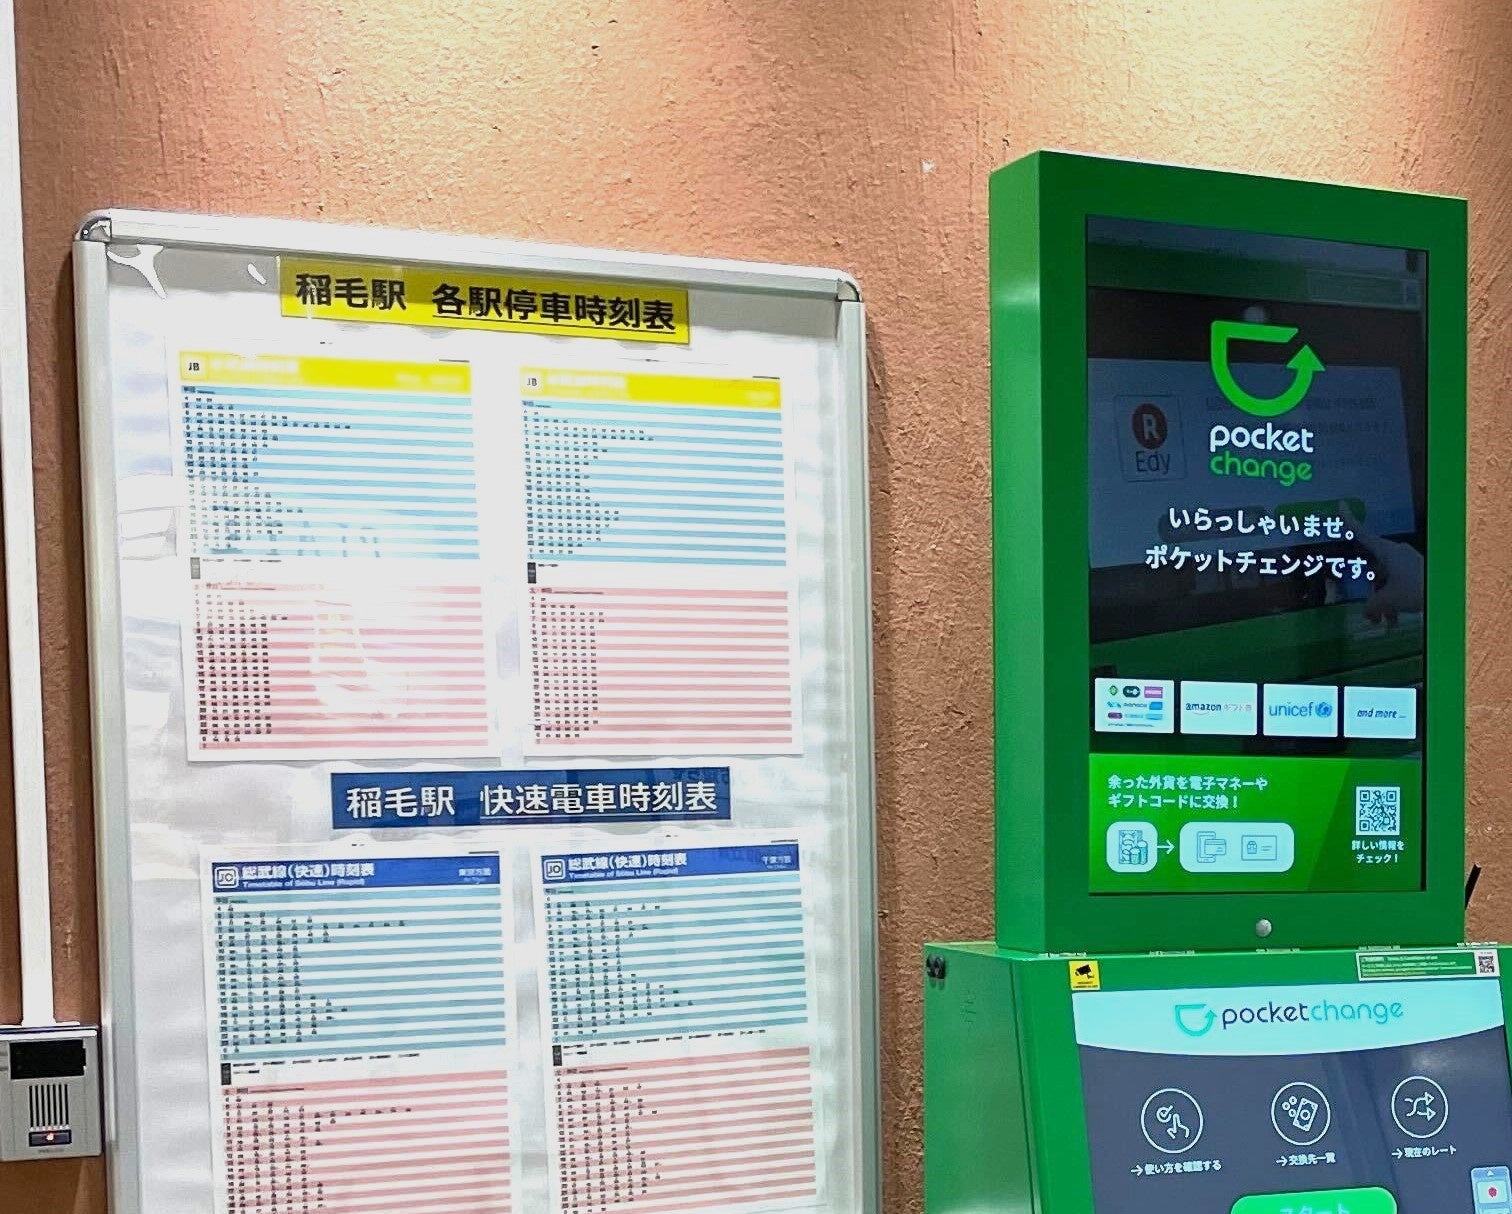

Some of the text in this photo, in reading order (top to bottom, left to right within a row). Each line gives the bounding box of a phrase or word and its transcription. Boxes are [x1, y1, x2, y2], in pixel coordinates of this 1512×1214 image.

[295, 272, 676, 332] 稲毛駅 各駅停車時刻表
[1209, 422, 1314, 453] pocket
[1135, 450, 1171, 476] Edy
[1209, 450, 1313, 487] change
[1168, 507, 1355, 541] いらっしゃいませ。
[1145, 544, 1376, 582] ポケットチェンジです。
[1185, 702, 1222, 712] amazon
[1268, 701, 1313, 717] unicef
[1107, 774, 1269, 791] 余った外貨を電子マネーや
[346, 781, 718, 819] 稲毛駅 快速電車時刻表
[1222, 1000, 1405, 1030] pocketchange
[1403, 1143, 1457, 1159] 現在のレート
[1144, 1158, 1222, 1176] 使い方を確認する
